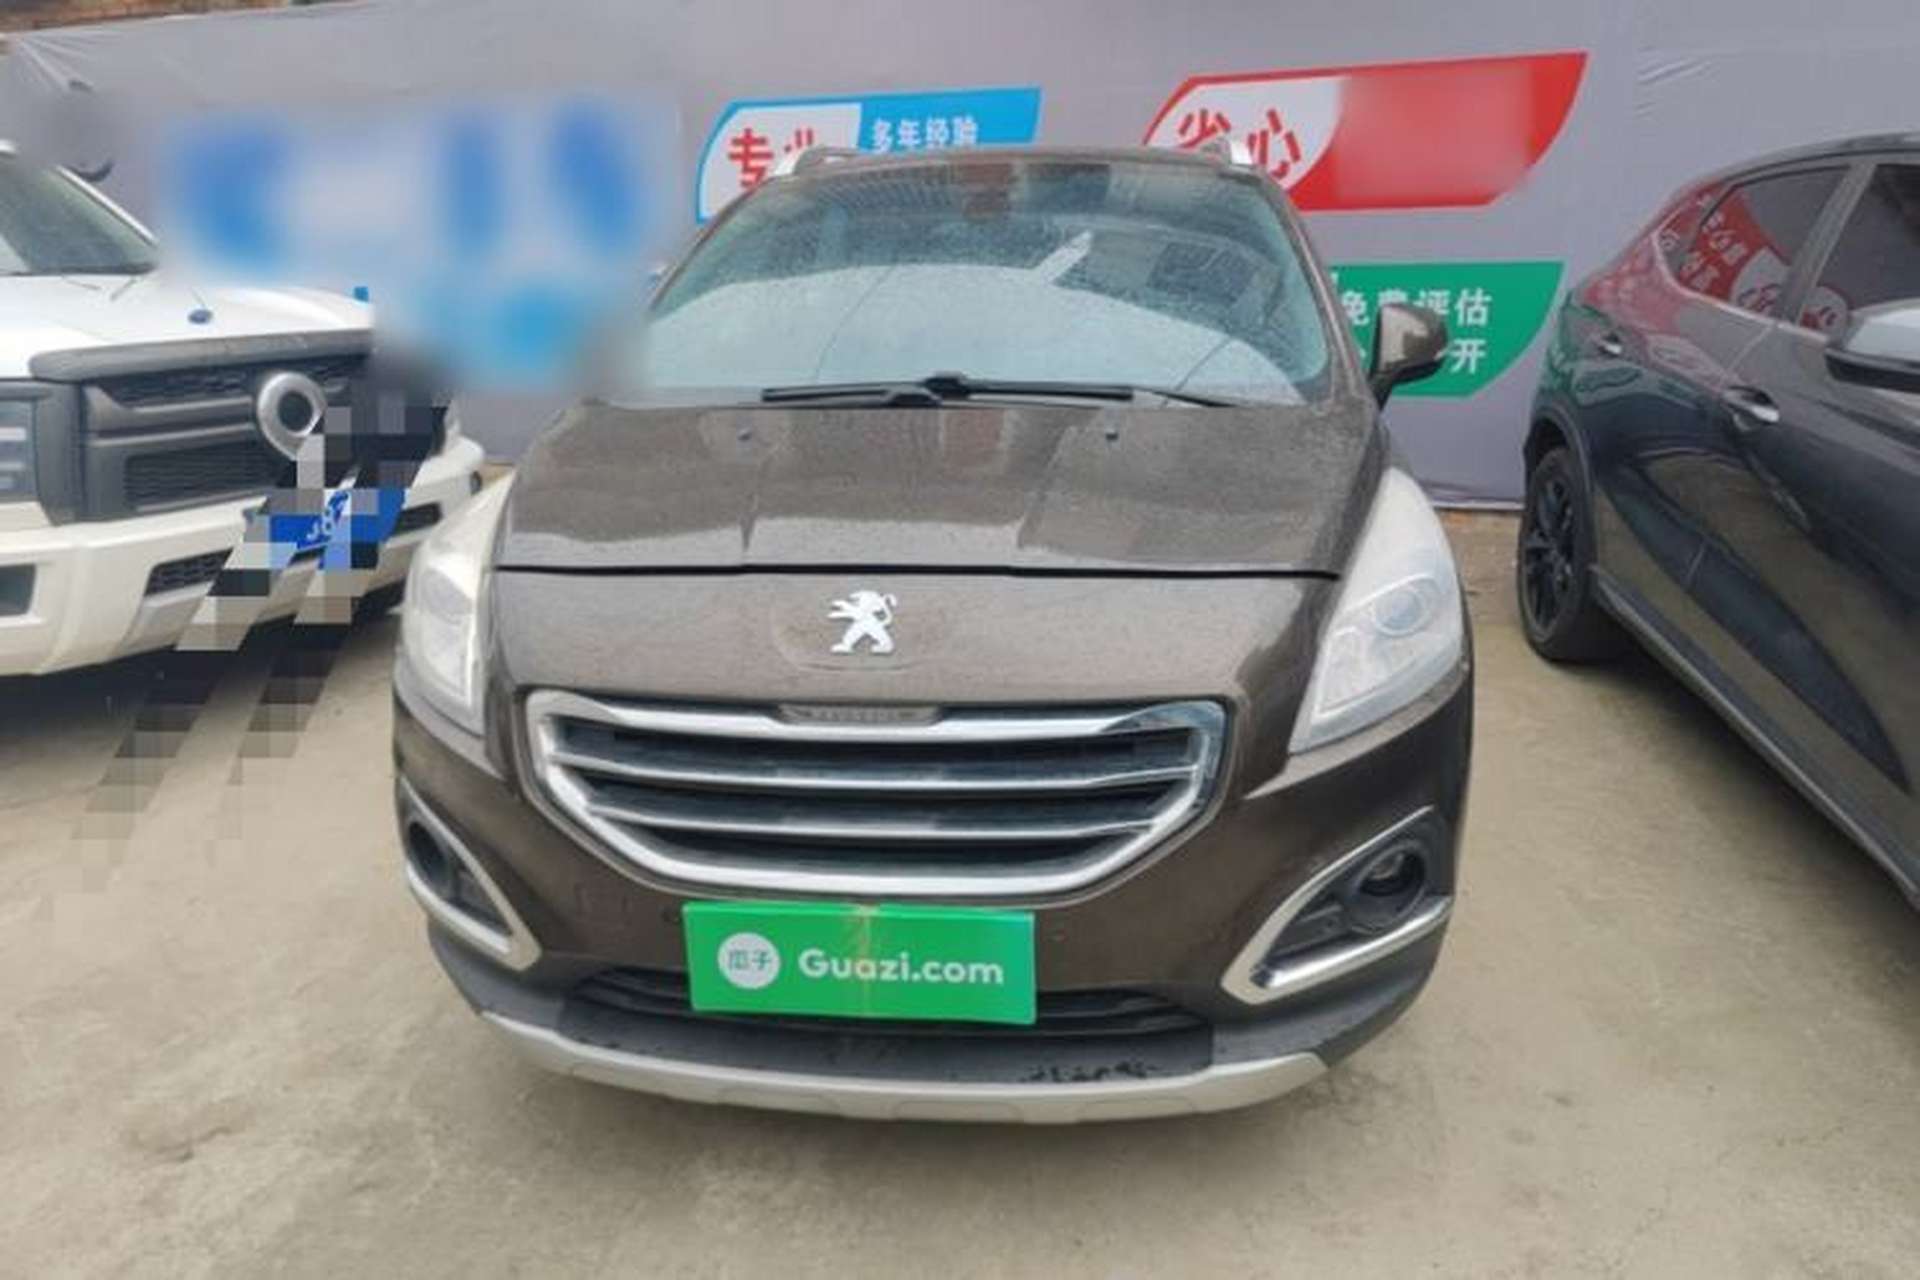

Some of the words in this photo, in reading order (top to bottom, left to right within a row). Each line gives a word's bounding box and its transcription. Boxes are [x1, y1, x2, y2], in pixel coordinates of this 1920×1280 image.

[870, 117, 979, 154] 多年经验
[797, 948, 1005, 985] Guazi.com
